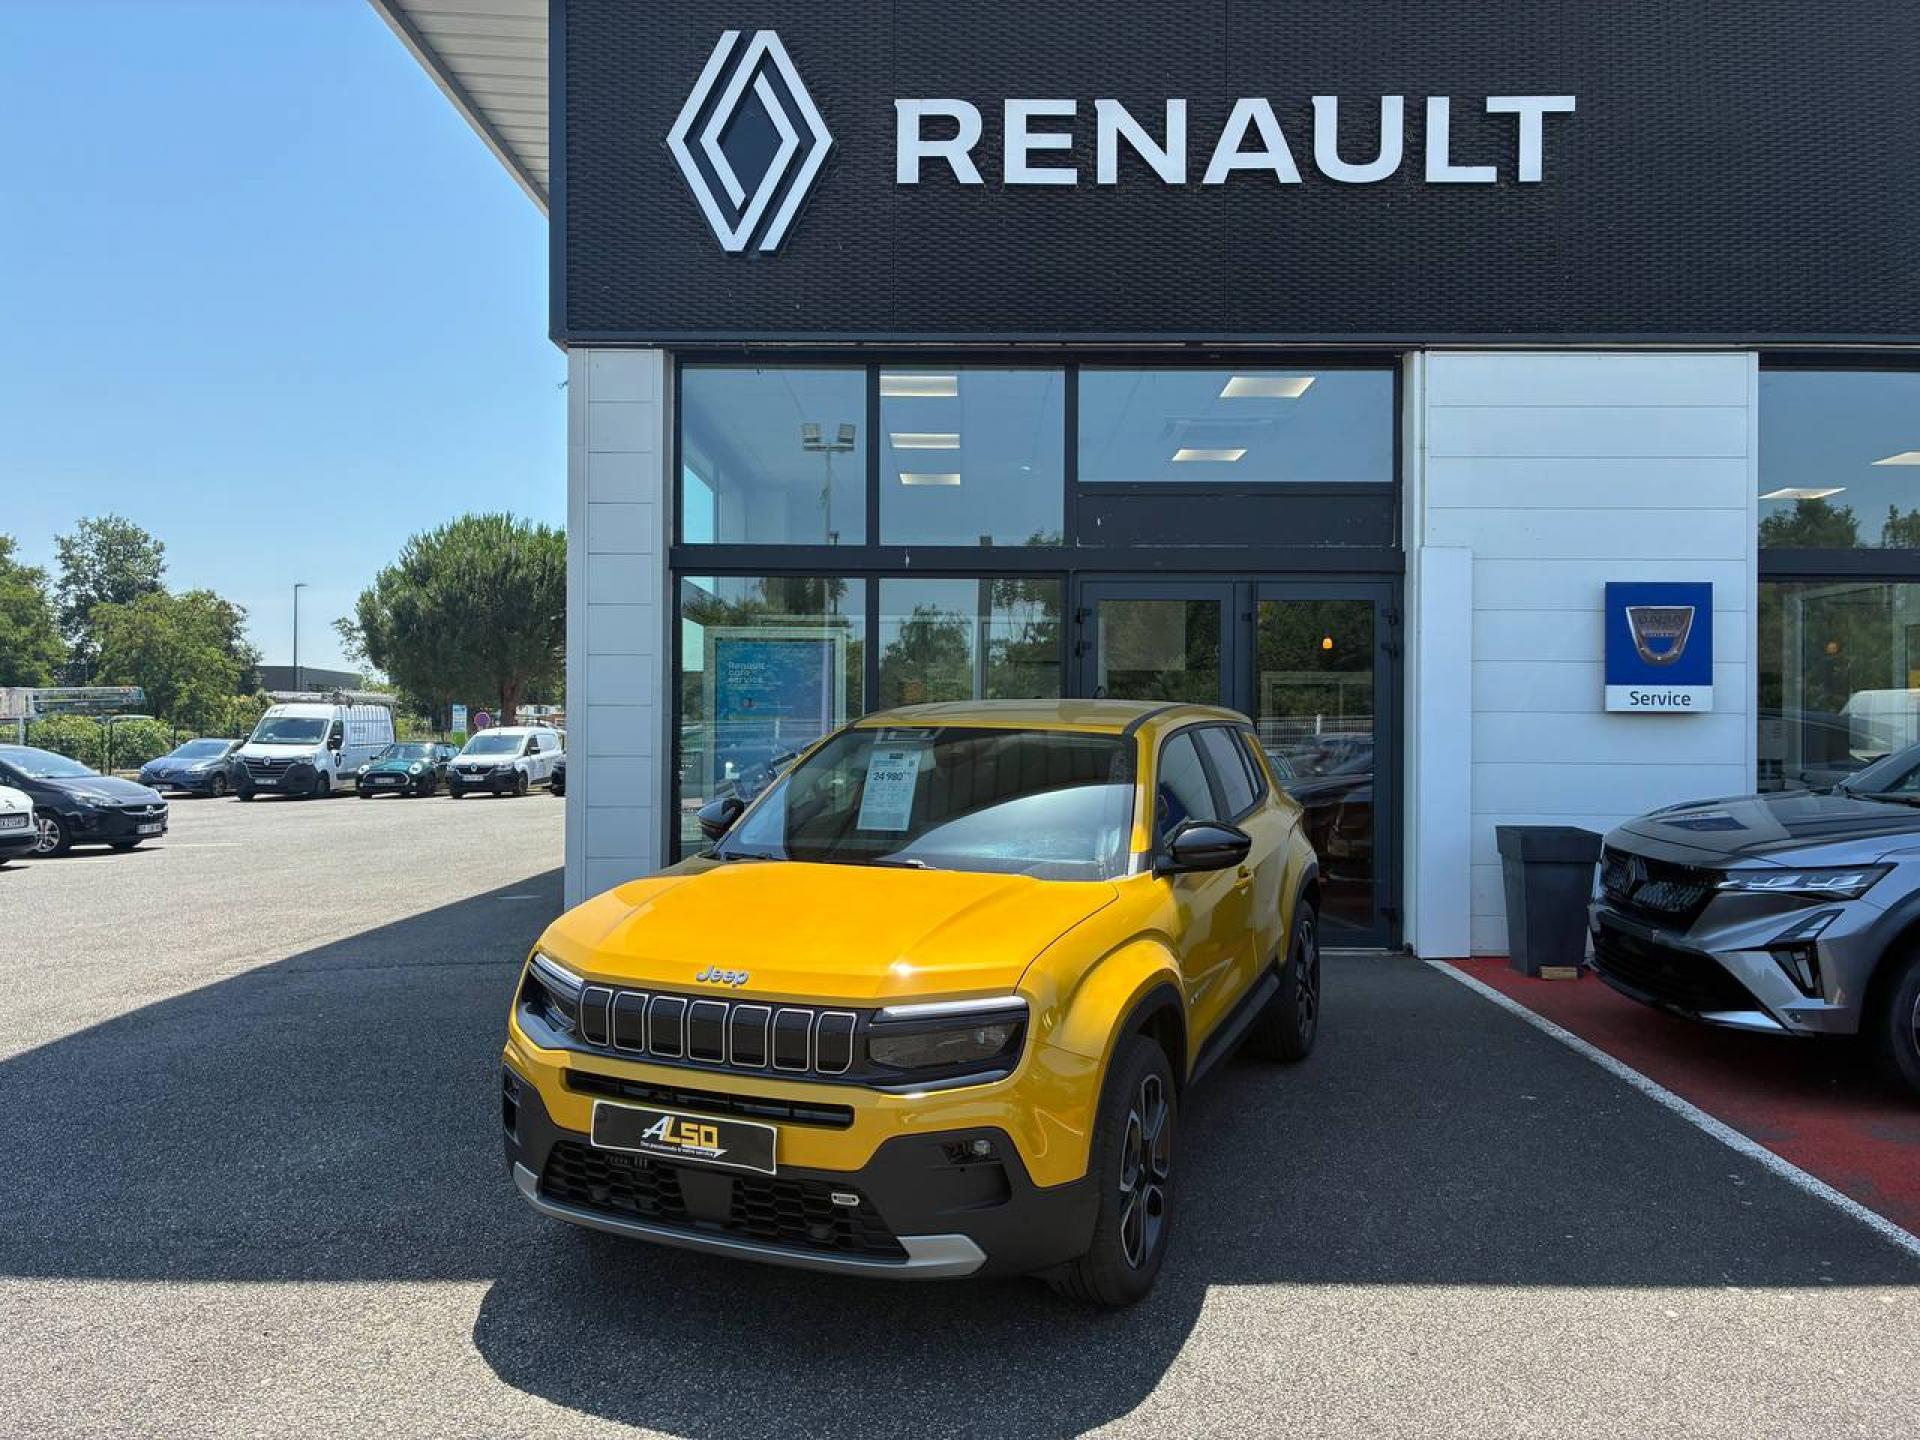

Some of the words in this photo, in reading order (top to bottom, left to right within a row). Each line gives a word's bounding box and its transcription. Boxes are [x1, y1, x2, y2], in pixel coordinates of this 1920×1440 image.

[894, 95, 1576, 184] RENAULT
[1630, 690, 1691, 706] Service
[873, 771, 884, 781] 24
[886, 771, 904, 781] 980
[695, 964, 748, 987] Jeep
[641, 1115, 719, 1149] ALSO
